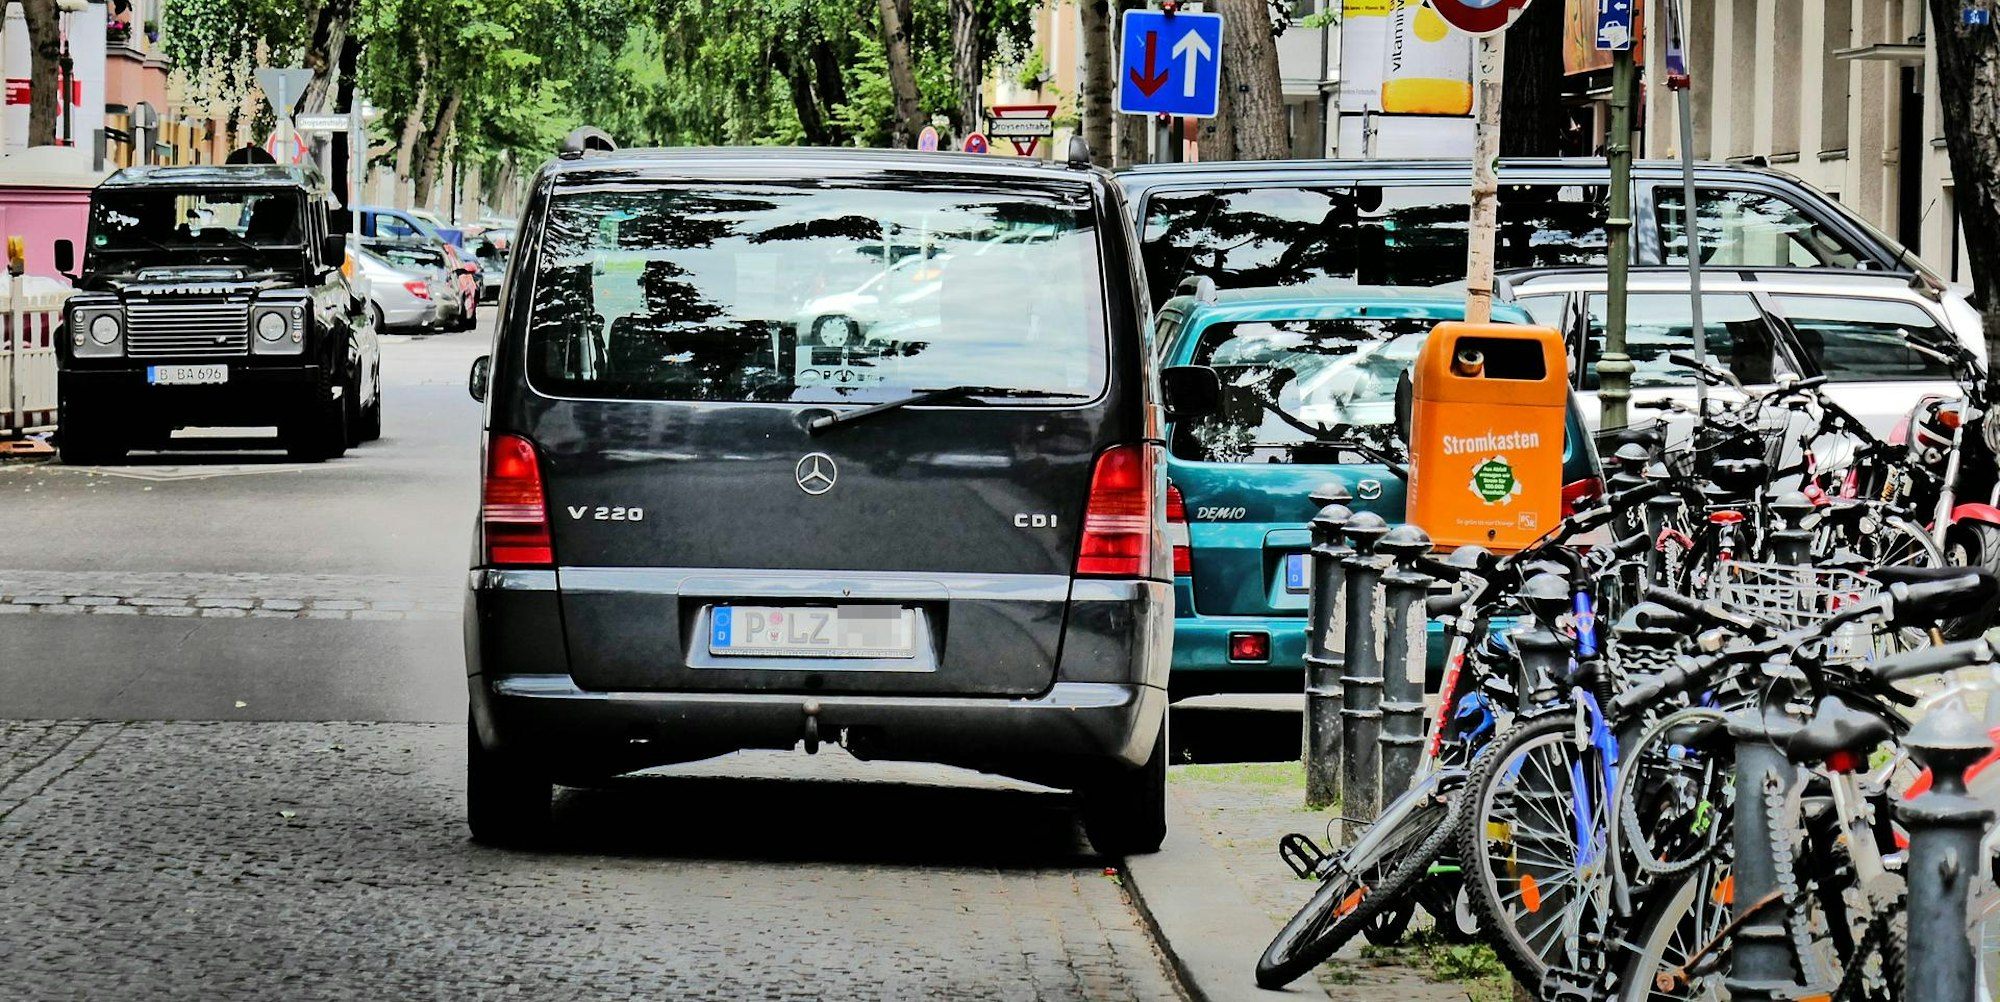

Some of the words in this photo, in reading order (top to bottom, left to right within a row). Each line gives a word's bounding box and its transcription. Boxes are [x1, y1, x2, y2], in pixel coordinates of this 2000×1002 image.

[991, 121, 1050, 132] Droysenstraße
[160, 369, 168, 380] B
[177, 368, 194, 380] BA
[197, 368, 221, 380] 696
[1443, 431, 1540, 455] Stromkasten
[567, 506, 588, 520] V
[594, 506, 644, 521] 220
[1014, 513, 1057, 528] CDI
[1197, 506, 1246, 522] DEMIO
[718, 631, 726, 641] D
[745, 612, 766, 643] P
[787, 612, 830, 645] LZ
